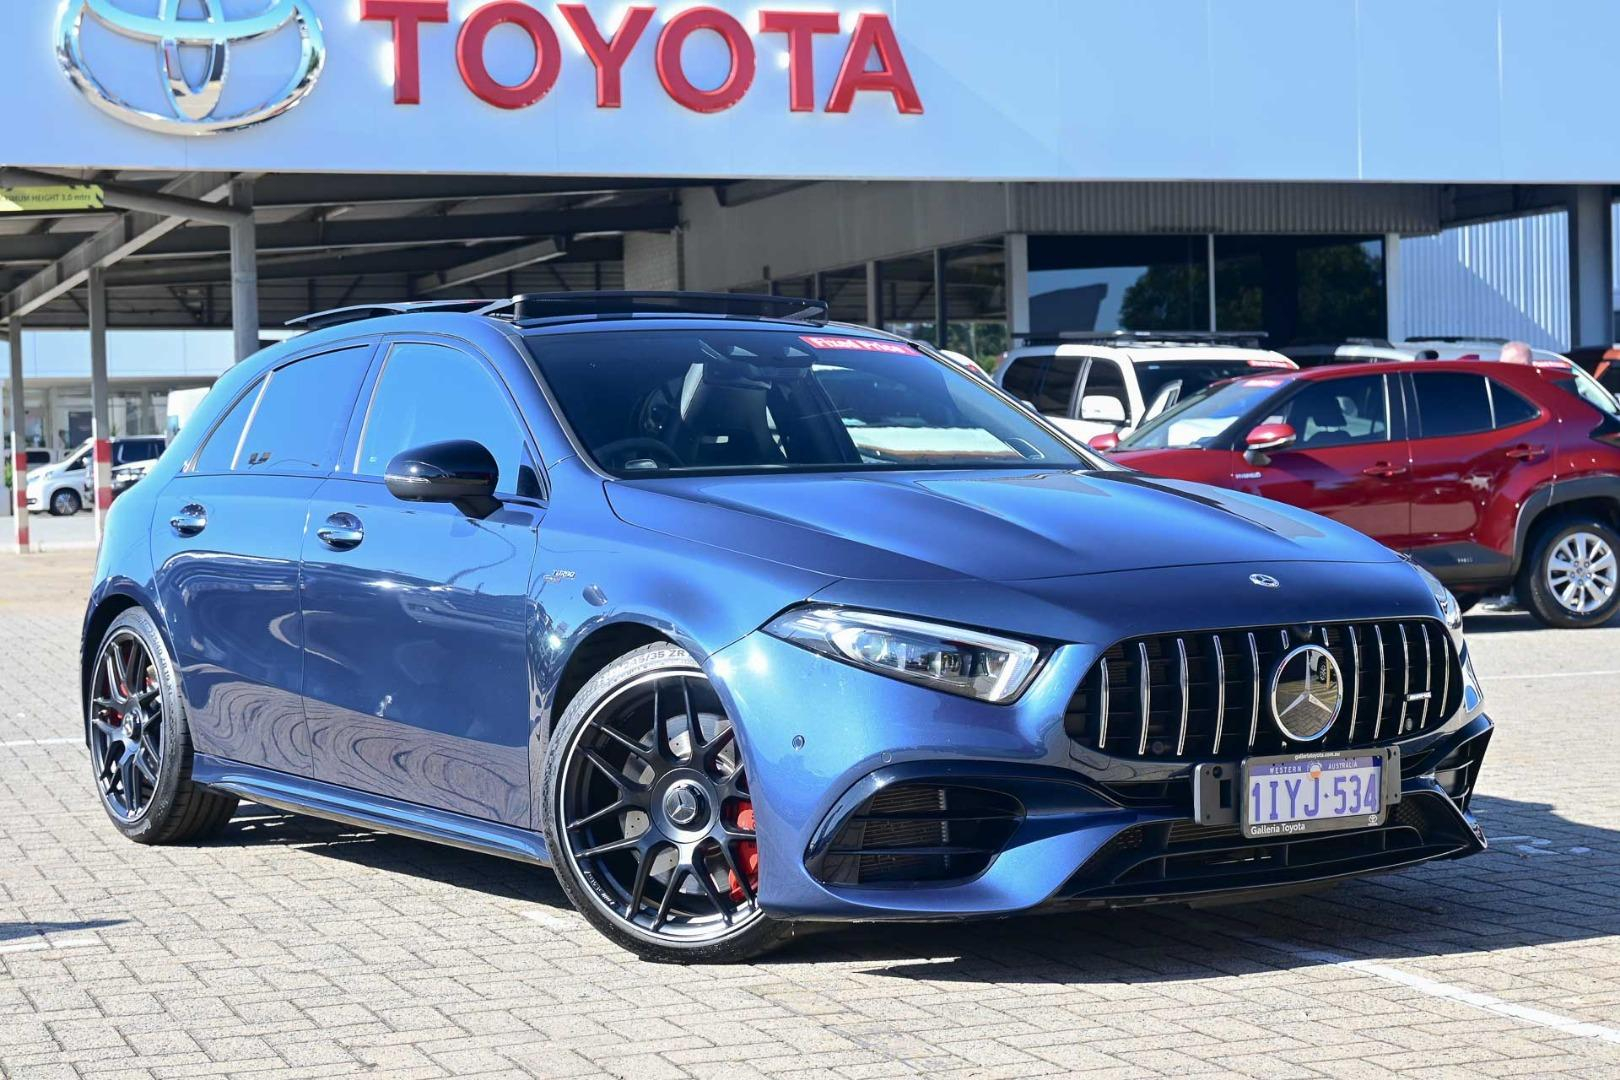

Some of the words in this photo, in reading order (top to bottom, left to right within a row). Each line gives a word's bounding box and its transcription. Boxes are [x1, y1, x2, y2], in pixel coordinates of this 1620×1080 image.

[360, 0, 924, 114] TOYOTA
[669, 648, 686, 658] ZR
[1269, 765, 1302, 775] WESTERN
[1327, 760, 1358, 770] AUSTRALIA
[1250, 824, 1281, 835] Galleria
[1281, 822, 1306, 834] Toyota
